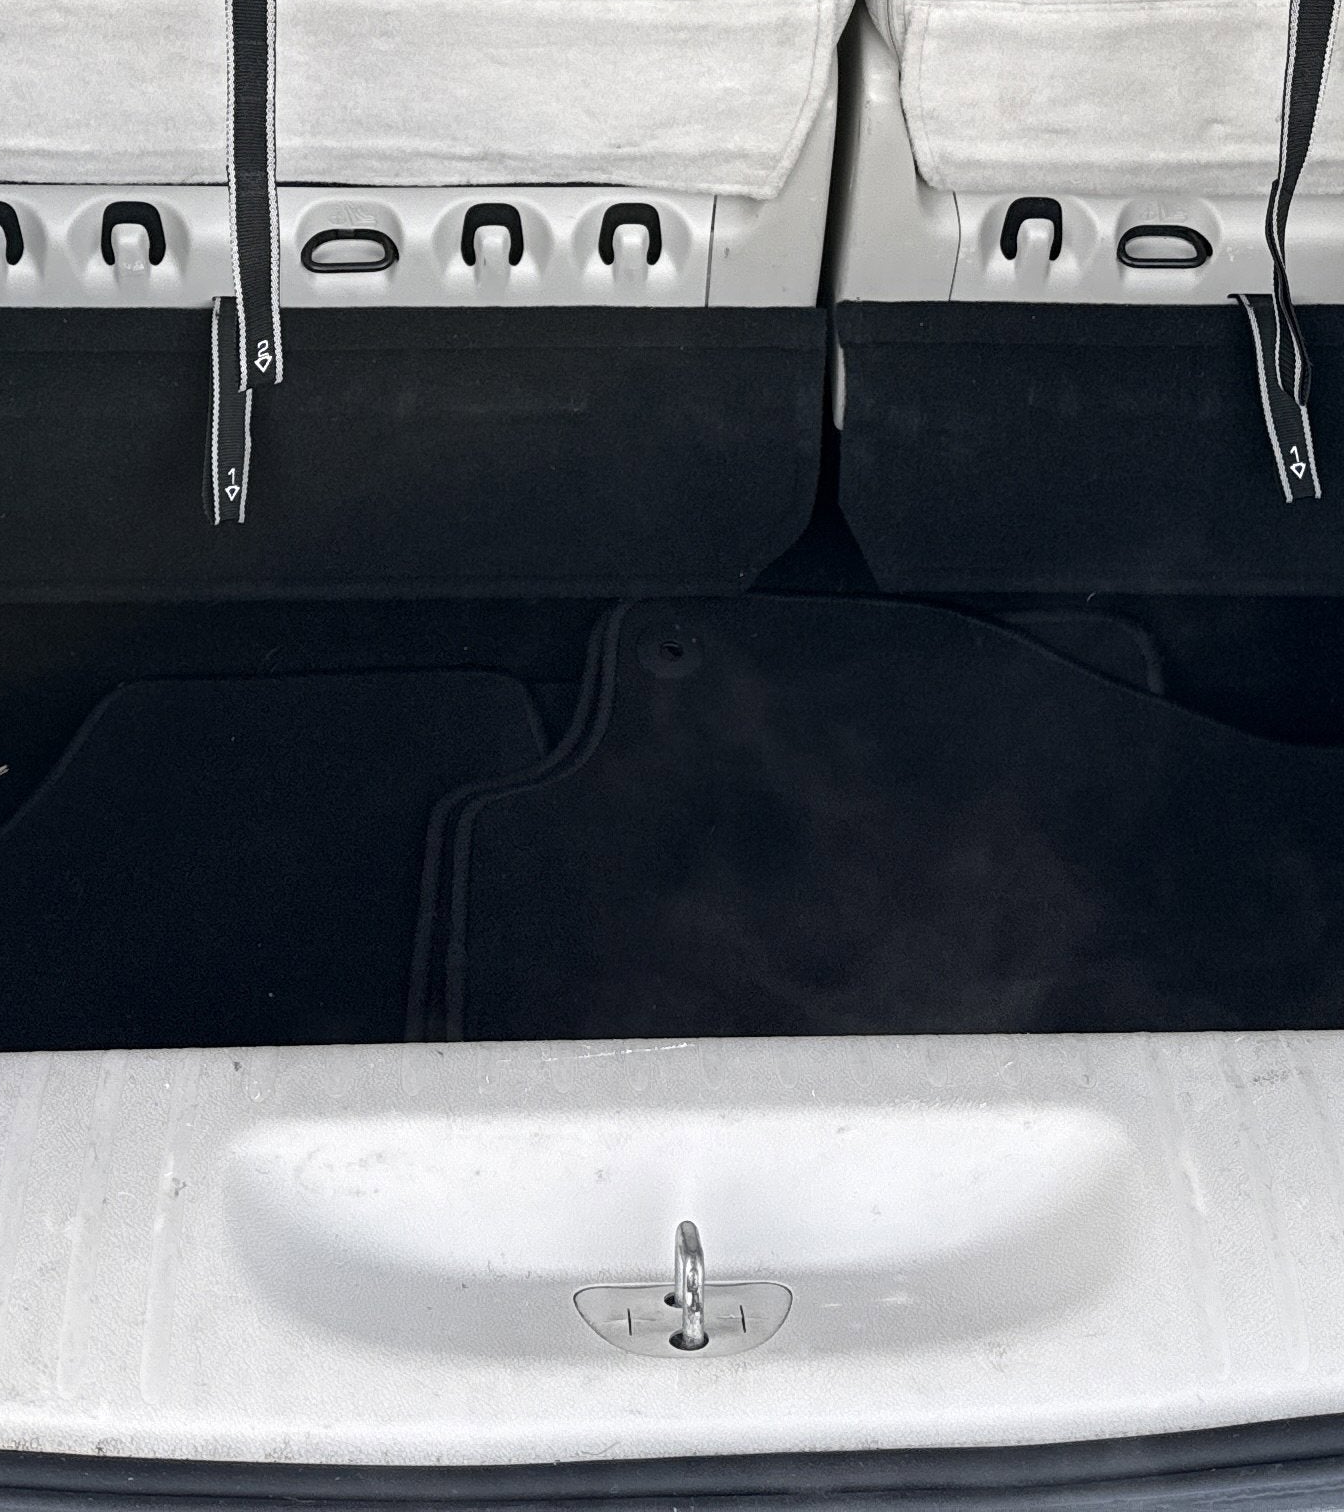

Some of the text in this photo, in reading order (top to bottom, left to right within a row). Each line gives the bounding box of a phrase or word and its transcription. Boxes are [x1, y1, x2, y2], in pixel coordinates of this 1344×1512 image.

[256, 339, 269, 357] 2
[1290, 445, 1300, 463] 1
[227, 467, 236, 485] 1
